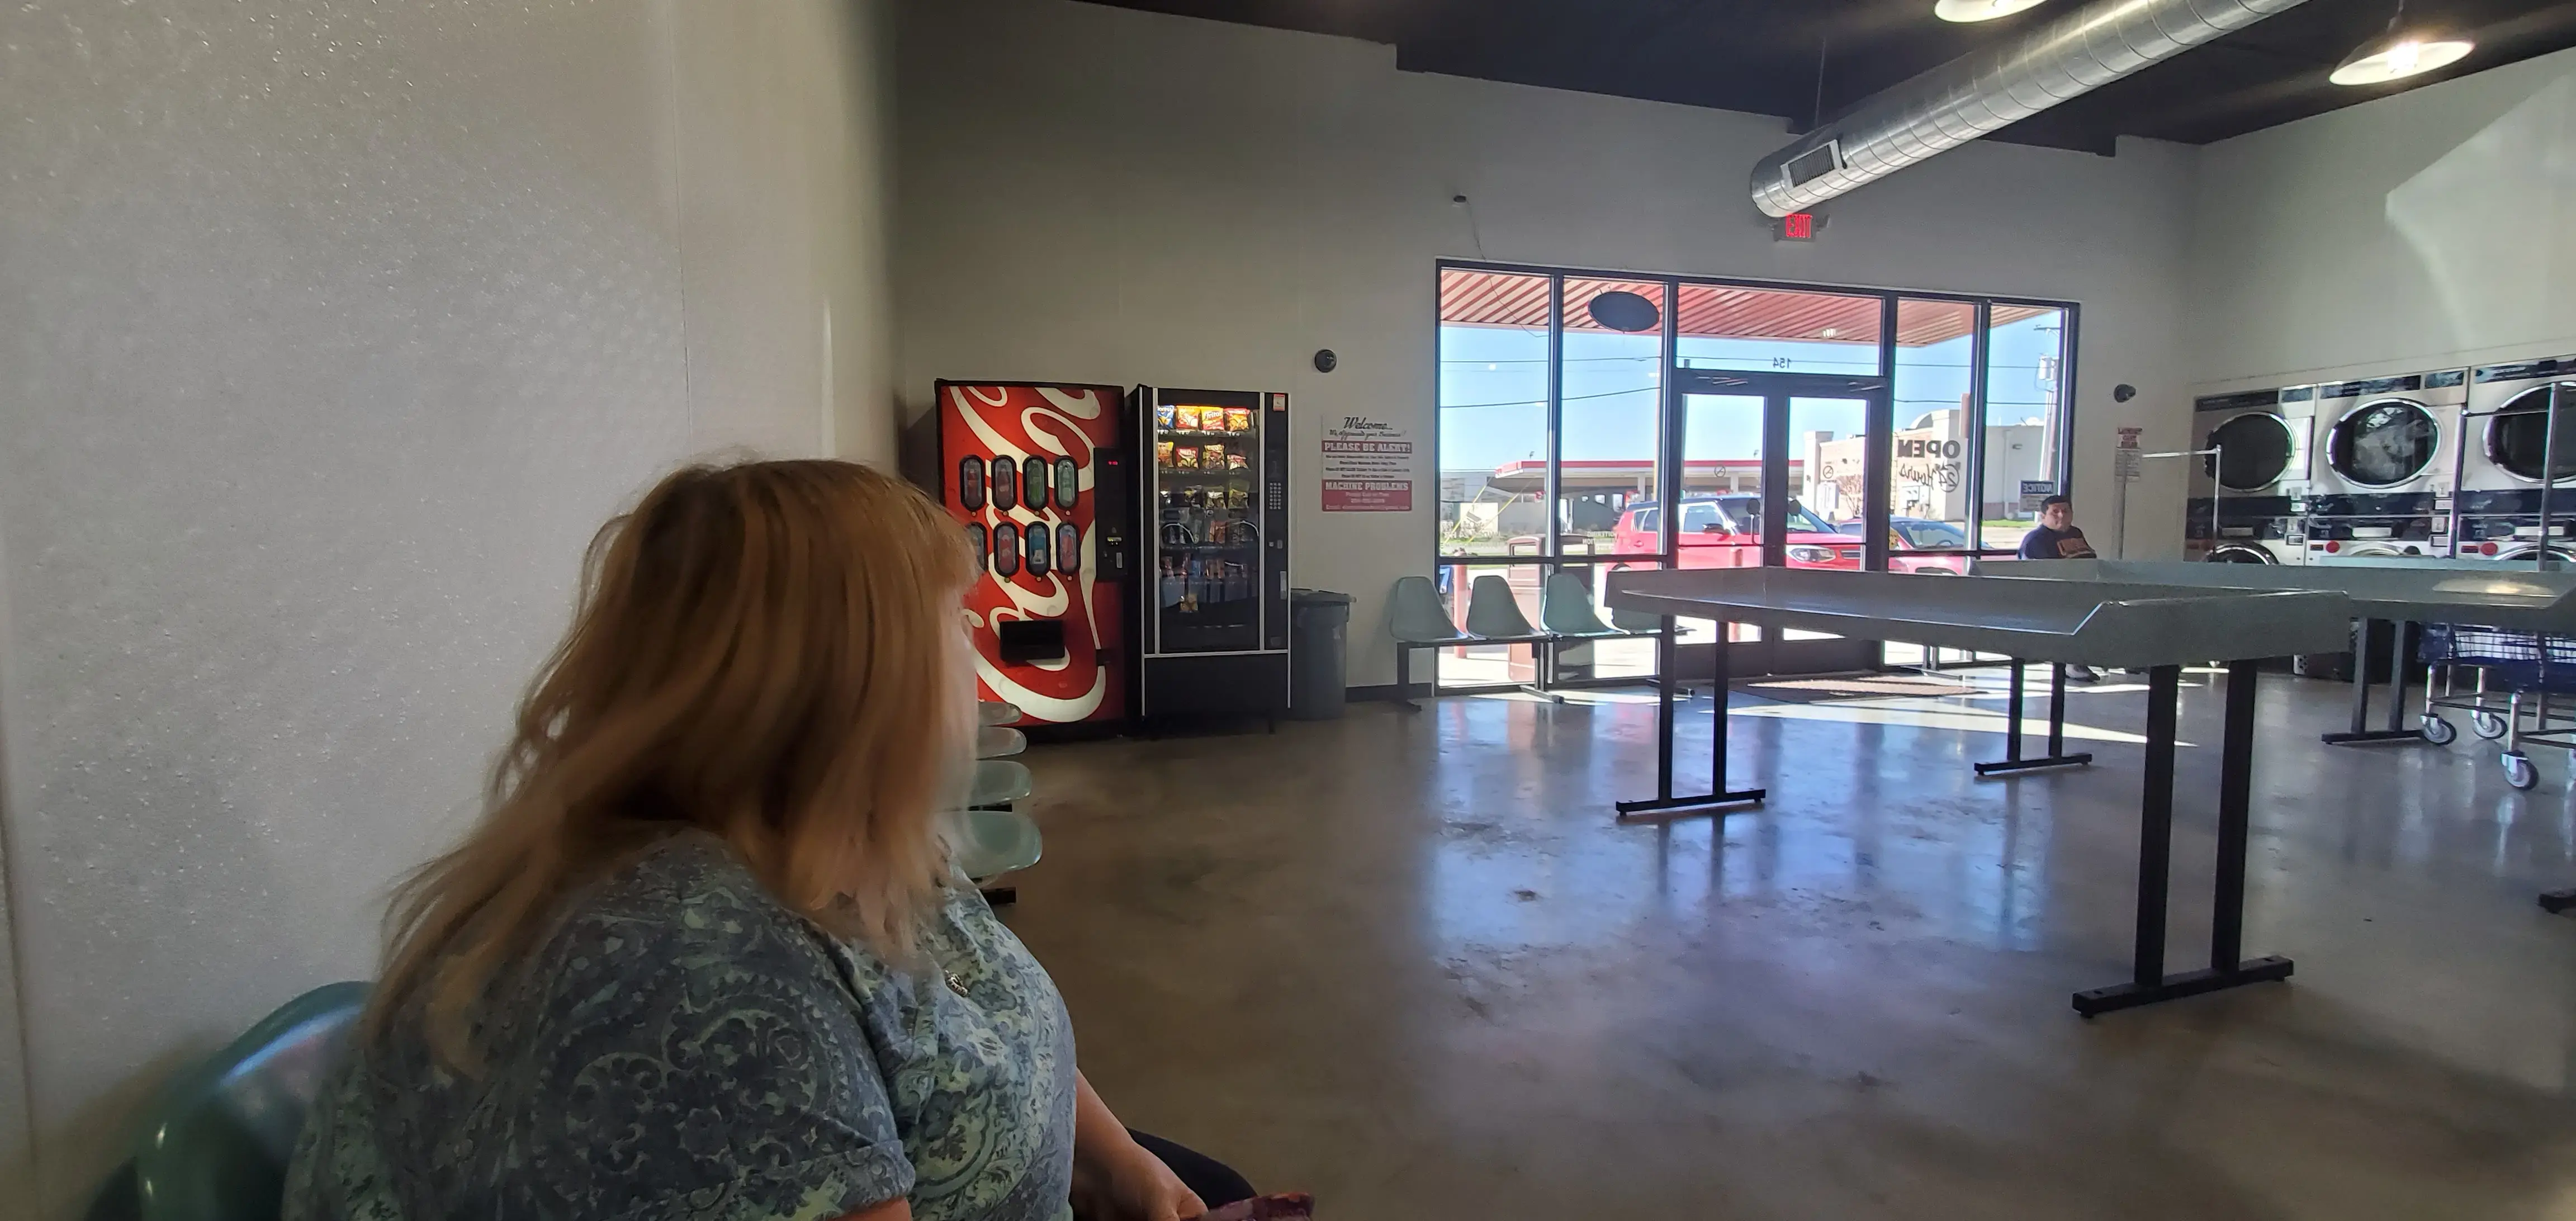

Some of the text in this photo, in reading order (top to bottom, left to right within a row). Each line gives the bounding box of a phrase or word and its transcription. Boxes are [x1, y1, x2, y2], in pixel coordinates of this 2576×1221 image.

[1786, 214, 1812, 238] EXIT
[1324, 442, 1360, 451] PLEASE
[1377, 443, 1410, 452] ALERT!
[1325, 482, 1409, 491] MACHINE PROBLEMS
